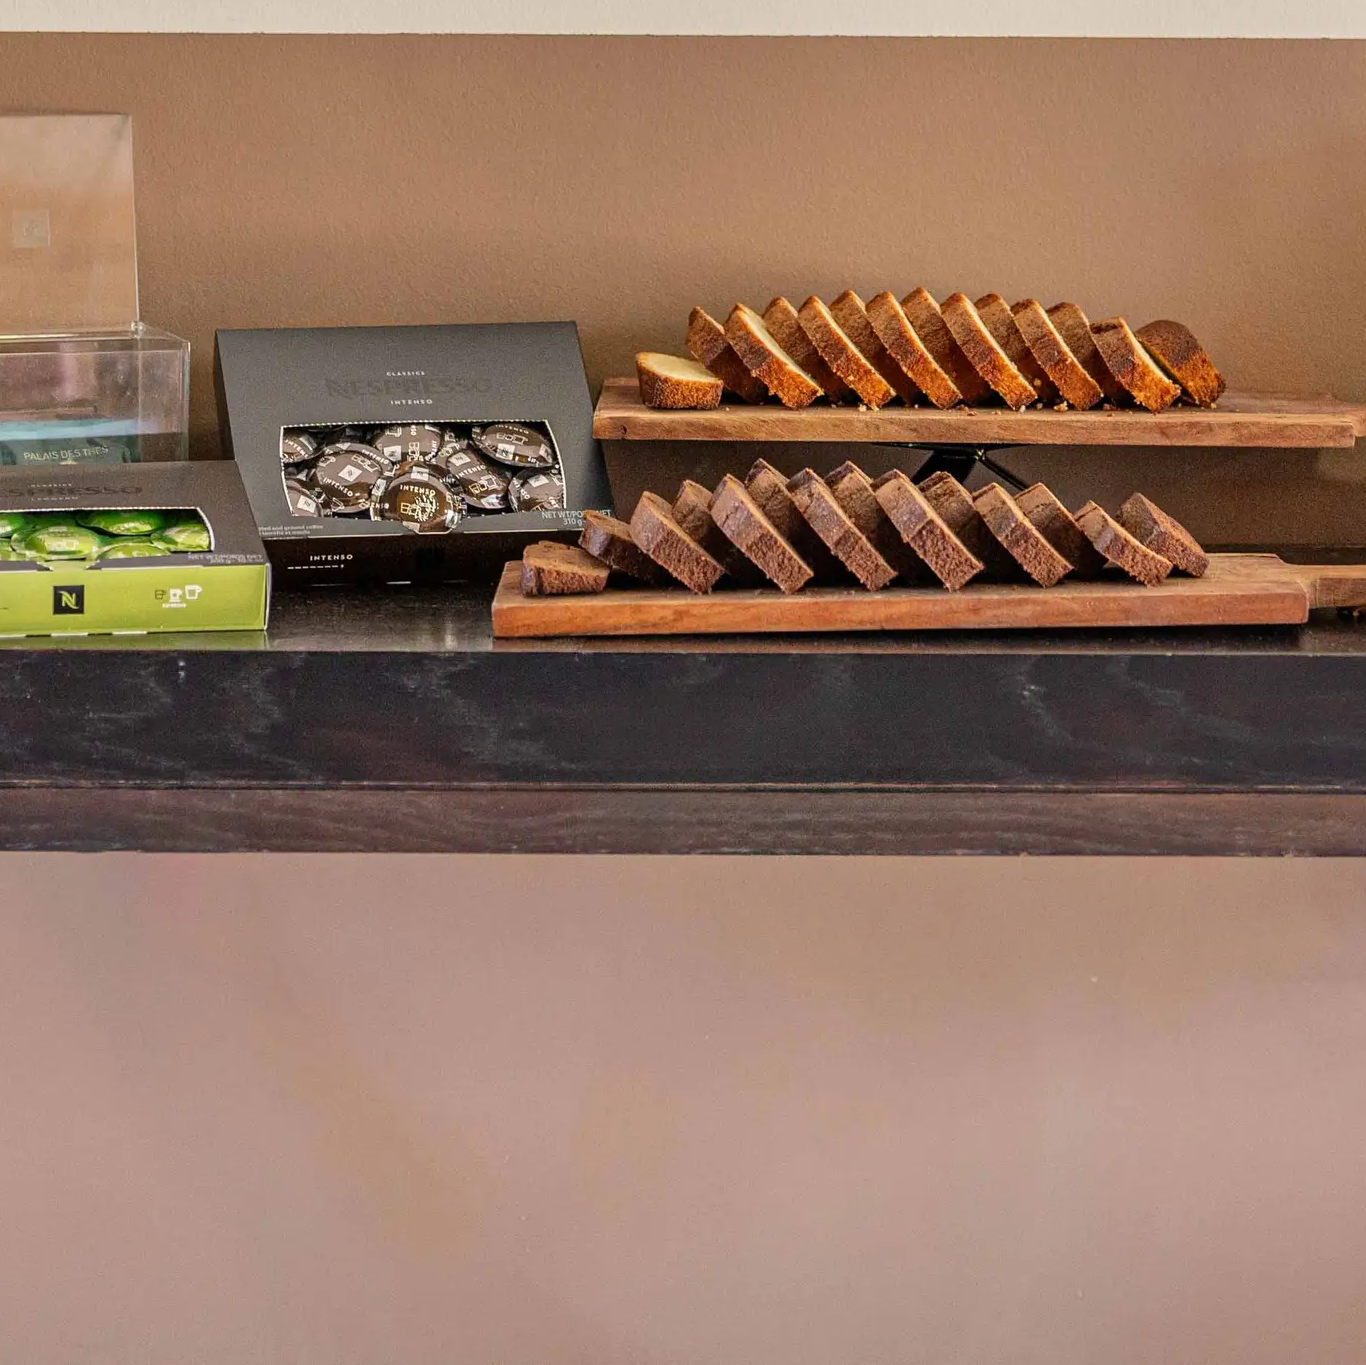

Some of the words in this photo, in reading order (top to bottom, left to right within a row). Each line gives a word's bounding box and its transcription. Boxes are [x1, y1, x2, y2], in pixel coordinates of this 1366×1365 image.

[23, 451, 59, 461] PALAIS
[60, 449, 81, 459] DES
[323, 477, 353, 497] INTENSO
[400, 484, 436, 495] INTENSO
[542, 510, 557, 519] NET
[559, 510, 583, 519] WT/PO
